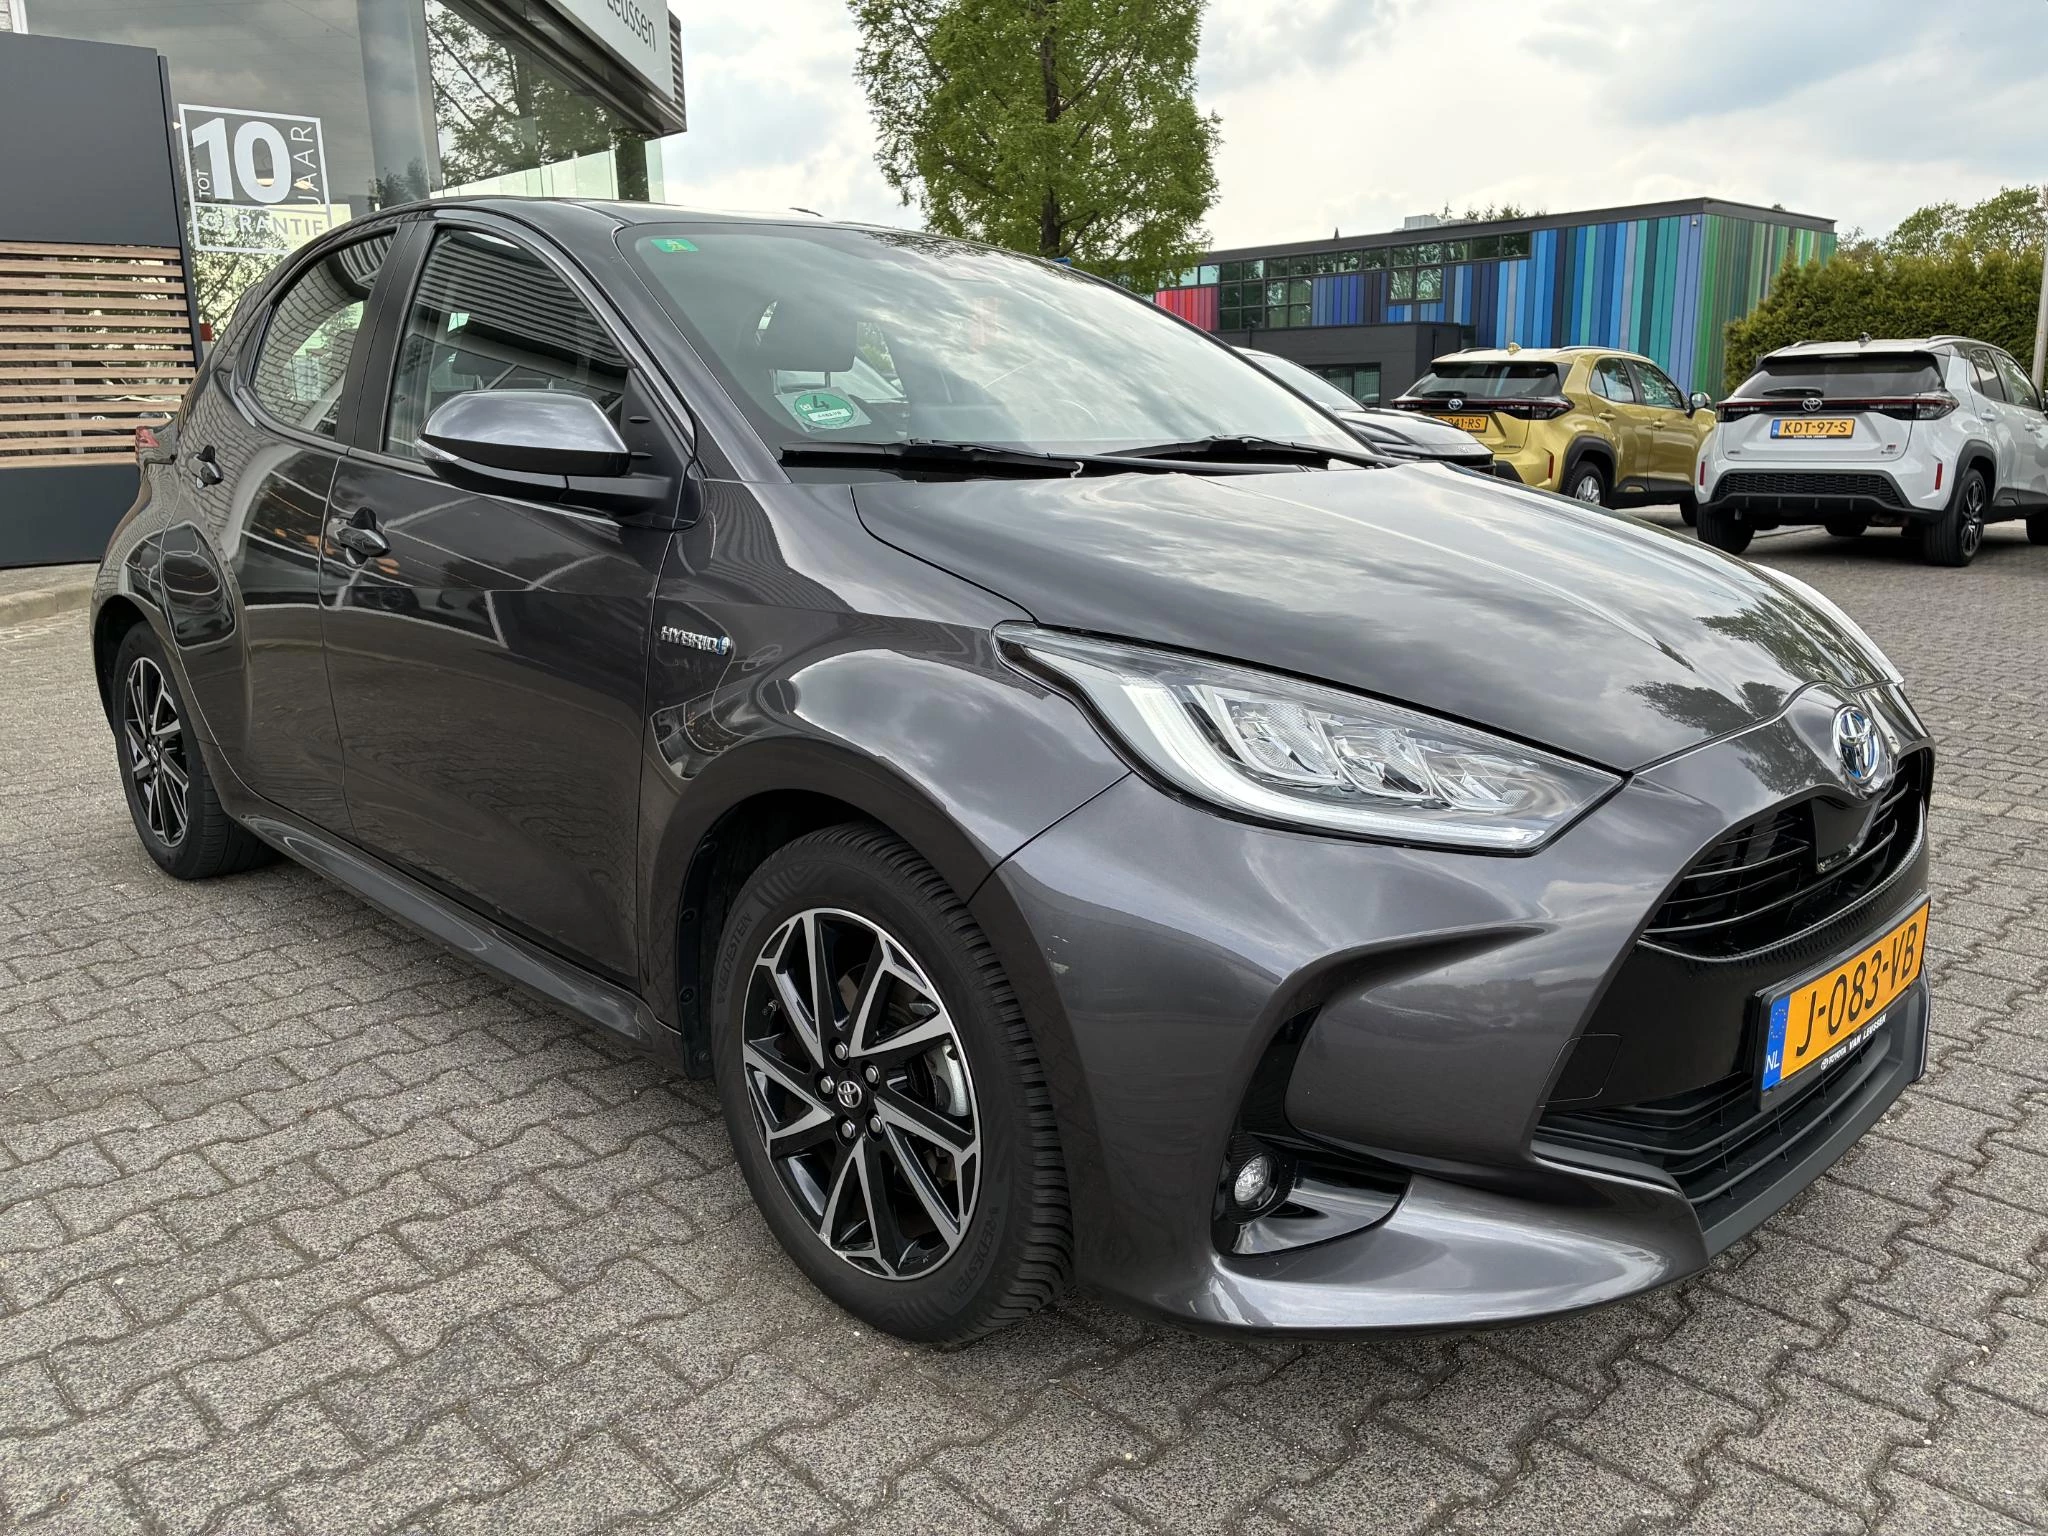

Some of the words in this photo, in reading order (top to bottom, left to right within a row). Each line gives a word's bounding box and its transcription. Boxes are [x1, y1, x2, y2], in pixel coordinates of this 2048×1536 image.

[607, 0, 656, 53] eussen
[191, 117, 292, 204] 10
[290, 126, 321, 206] JAAR
[196, 169, 211, 197] TOT
[1783, 421, 1848, 434] KDT-97-S
[660, 625, 718, 652] HYBRID
[1795, 921, 1918, 1057] J-083-VB
[1765, 1050, 1781, 1074] NL
